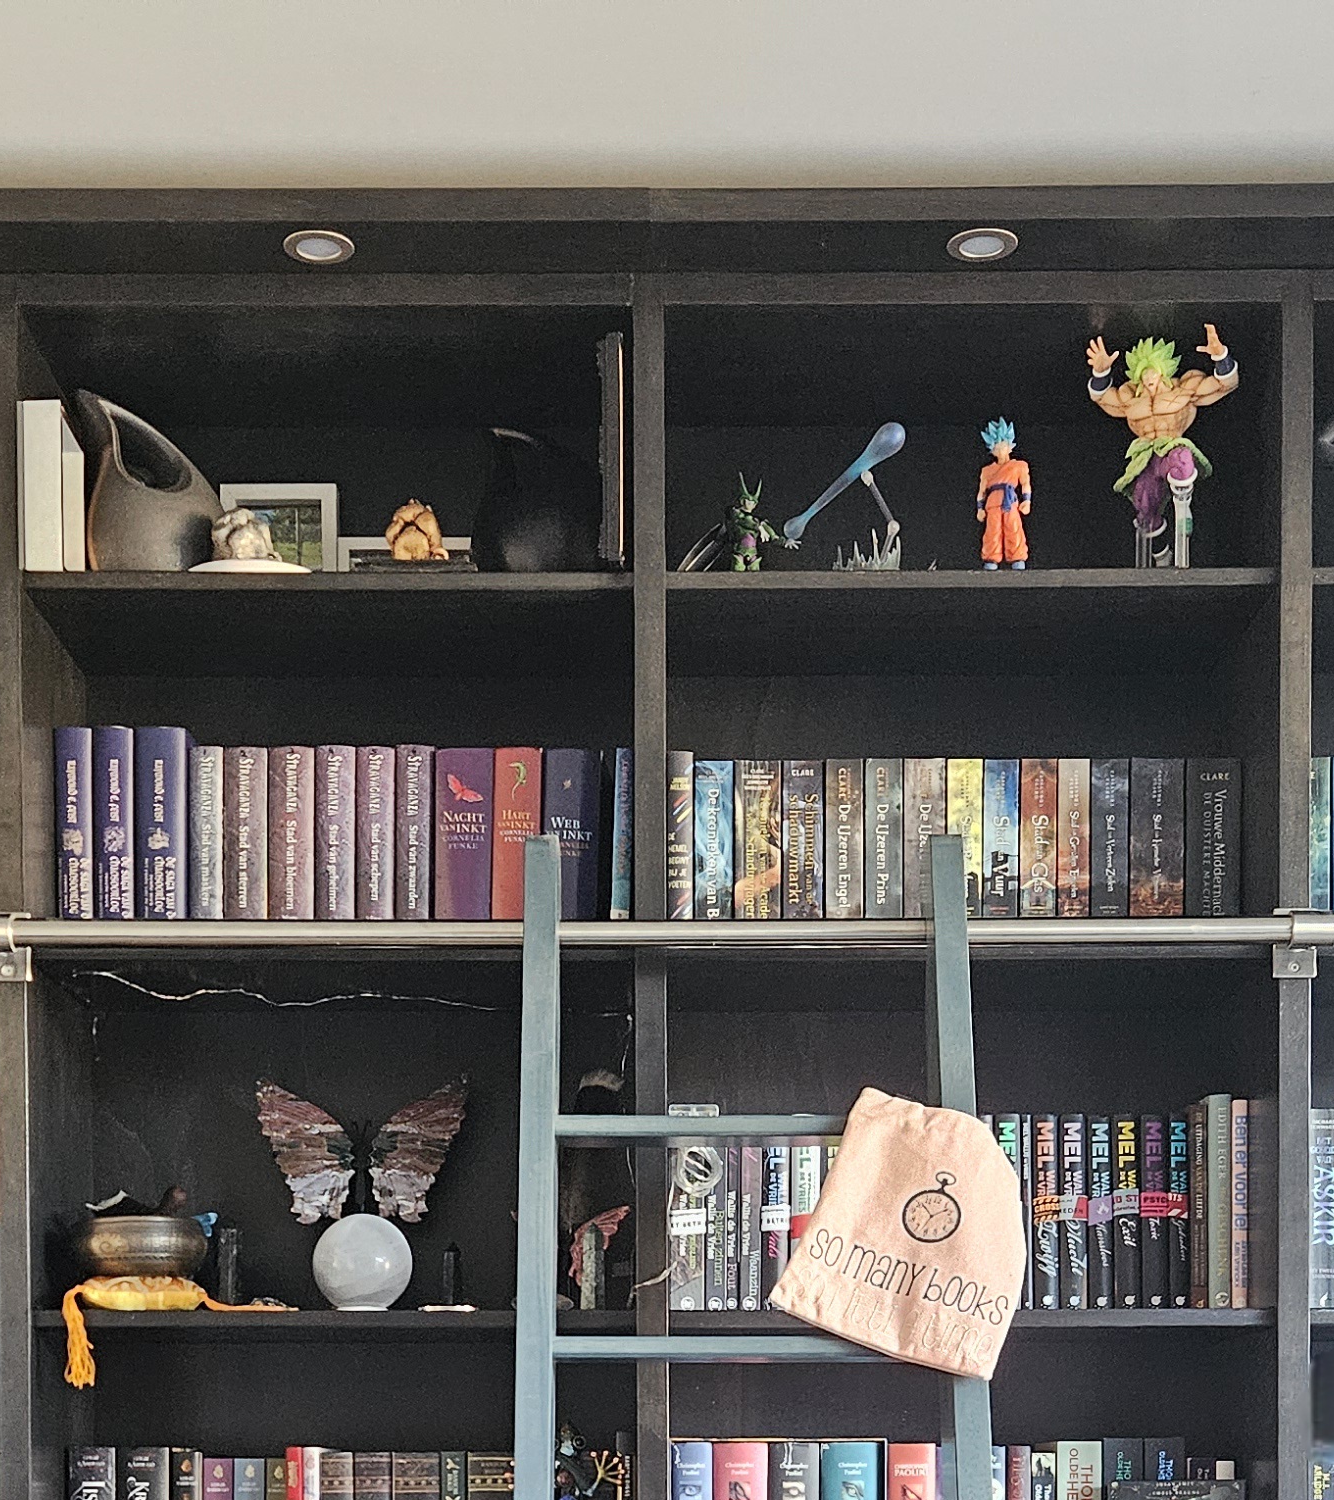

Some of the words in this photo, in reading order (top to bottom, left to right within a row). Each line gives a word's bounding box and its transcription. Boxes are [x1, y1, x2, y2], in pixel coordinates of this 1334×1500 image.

[367, 754, 384, 814] STRAVAGANZA
[441, 811, 484, 823] NACHT
[501, 810, 530, 820] HART
[550, 817, 579, 829] WEB
[839, 805, 851, 822] De
[370, 821, 382, 842] Stad
[994, 816, 1009, 845] Stad
[370, 845, 380, 861] van
[789, 794, 802, 904] schaduwmarkt
[367, 864, 382, 901] schepen
[837, 874, 851, 907] Engel
[992, 864, 1009, 896] Vuur
[1064, 1121, 1081, 1167] MEL
[1170, 1121, 1186, 1167] MEL
[1064, 1221, 1087, 1275] Vlucht
